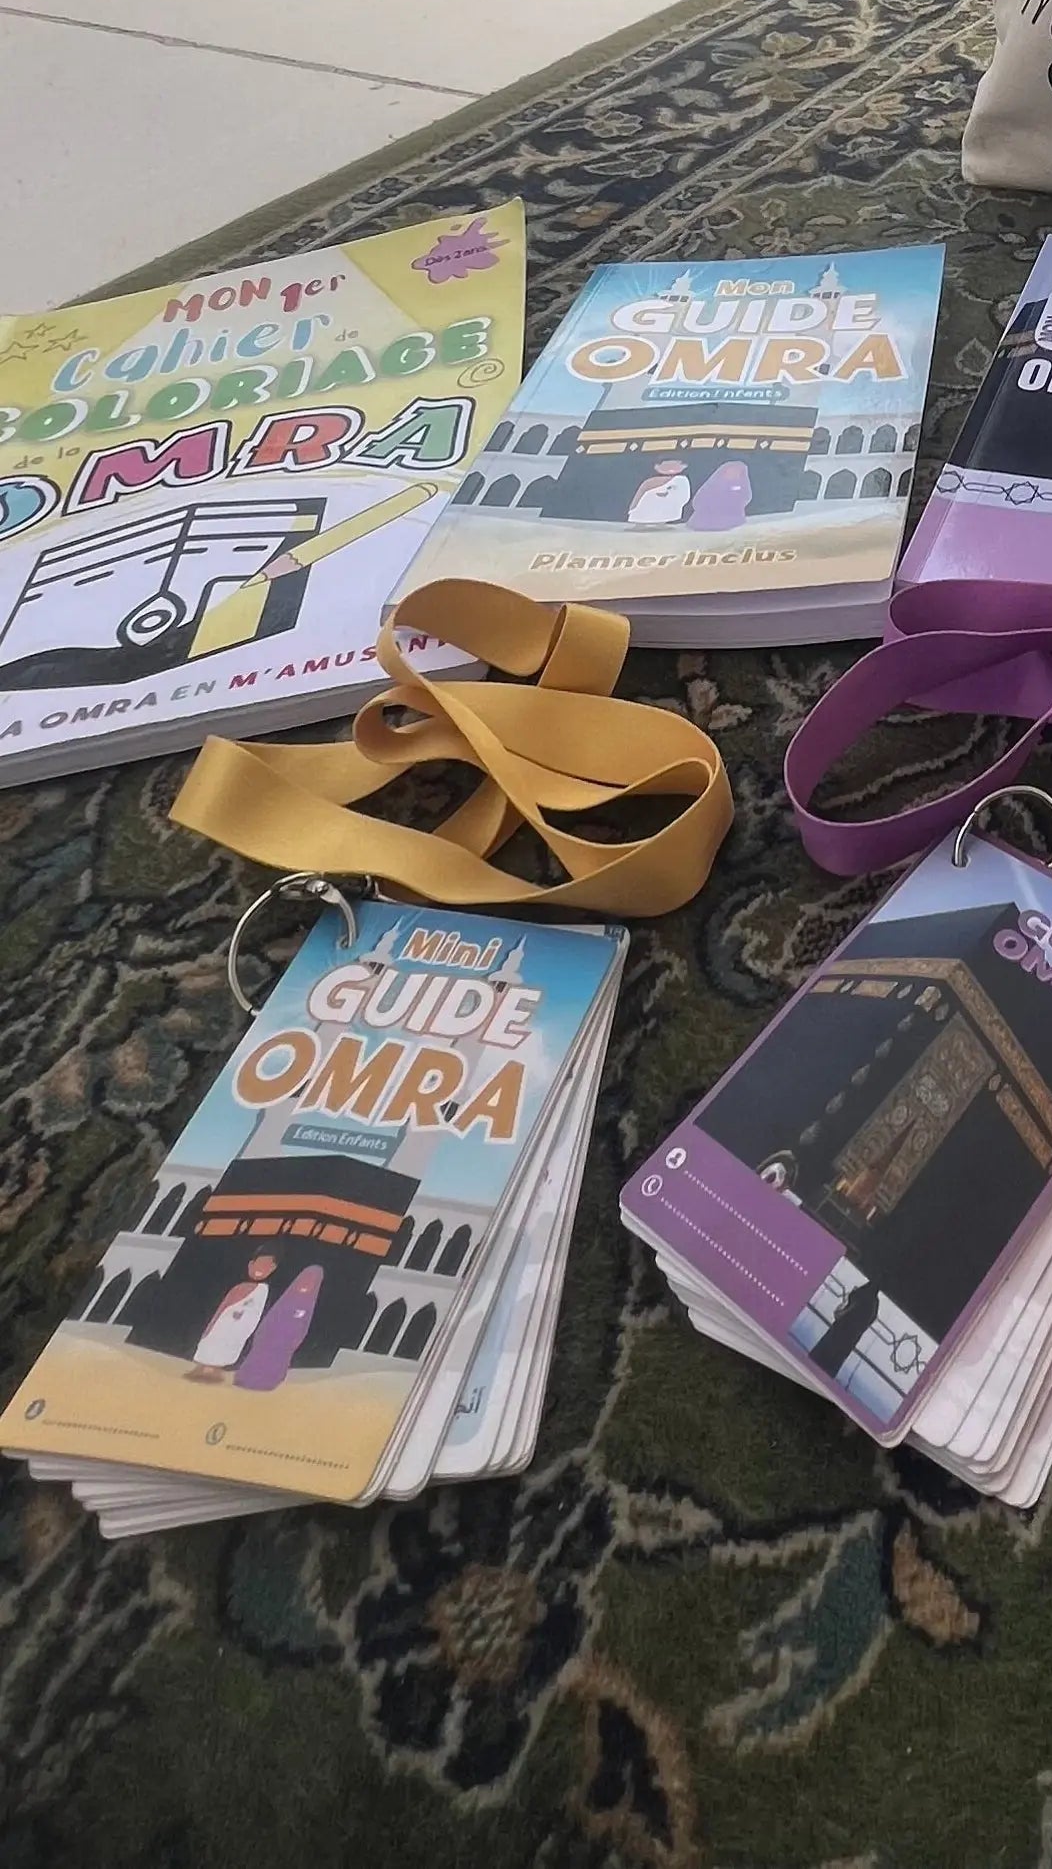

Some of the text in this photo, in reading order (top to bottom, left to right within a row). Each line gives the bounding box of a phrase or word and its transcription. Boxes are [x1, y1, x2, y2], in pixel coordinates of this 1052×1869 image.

[163, 274, 346, 322] MON 1er
[714, 278, 795, 298] Mon
[609, 293, 882, 336] GUIDE
[51, 314, 331, 395] Cahier
[567, 333, 909, 385] OMRA
[13, 455, 45, 470] de
[530, 547, 797, 572] Planner Inclus
[39, 691, 157, 729] OMRA
[169, 679, 218, 703] EN
[400, 927, 504, 971] Mini
[307, 963, 542, 1049] GUIDE
[232, 1028, 527, 1145] OMRA
